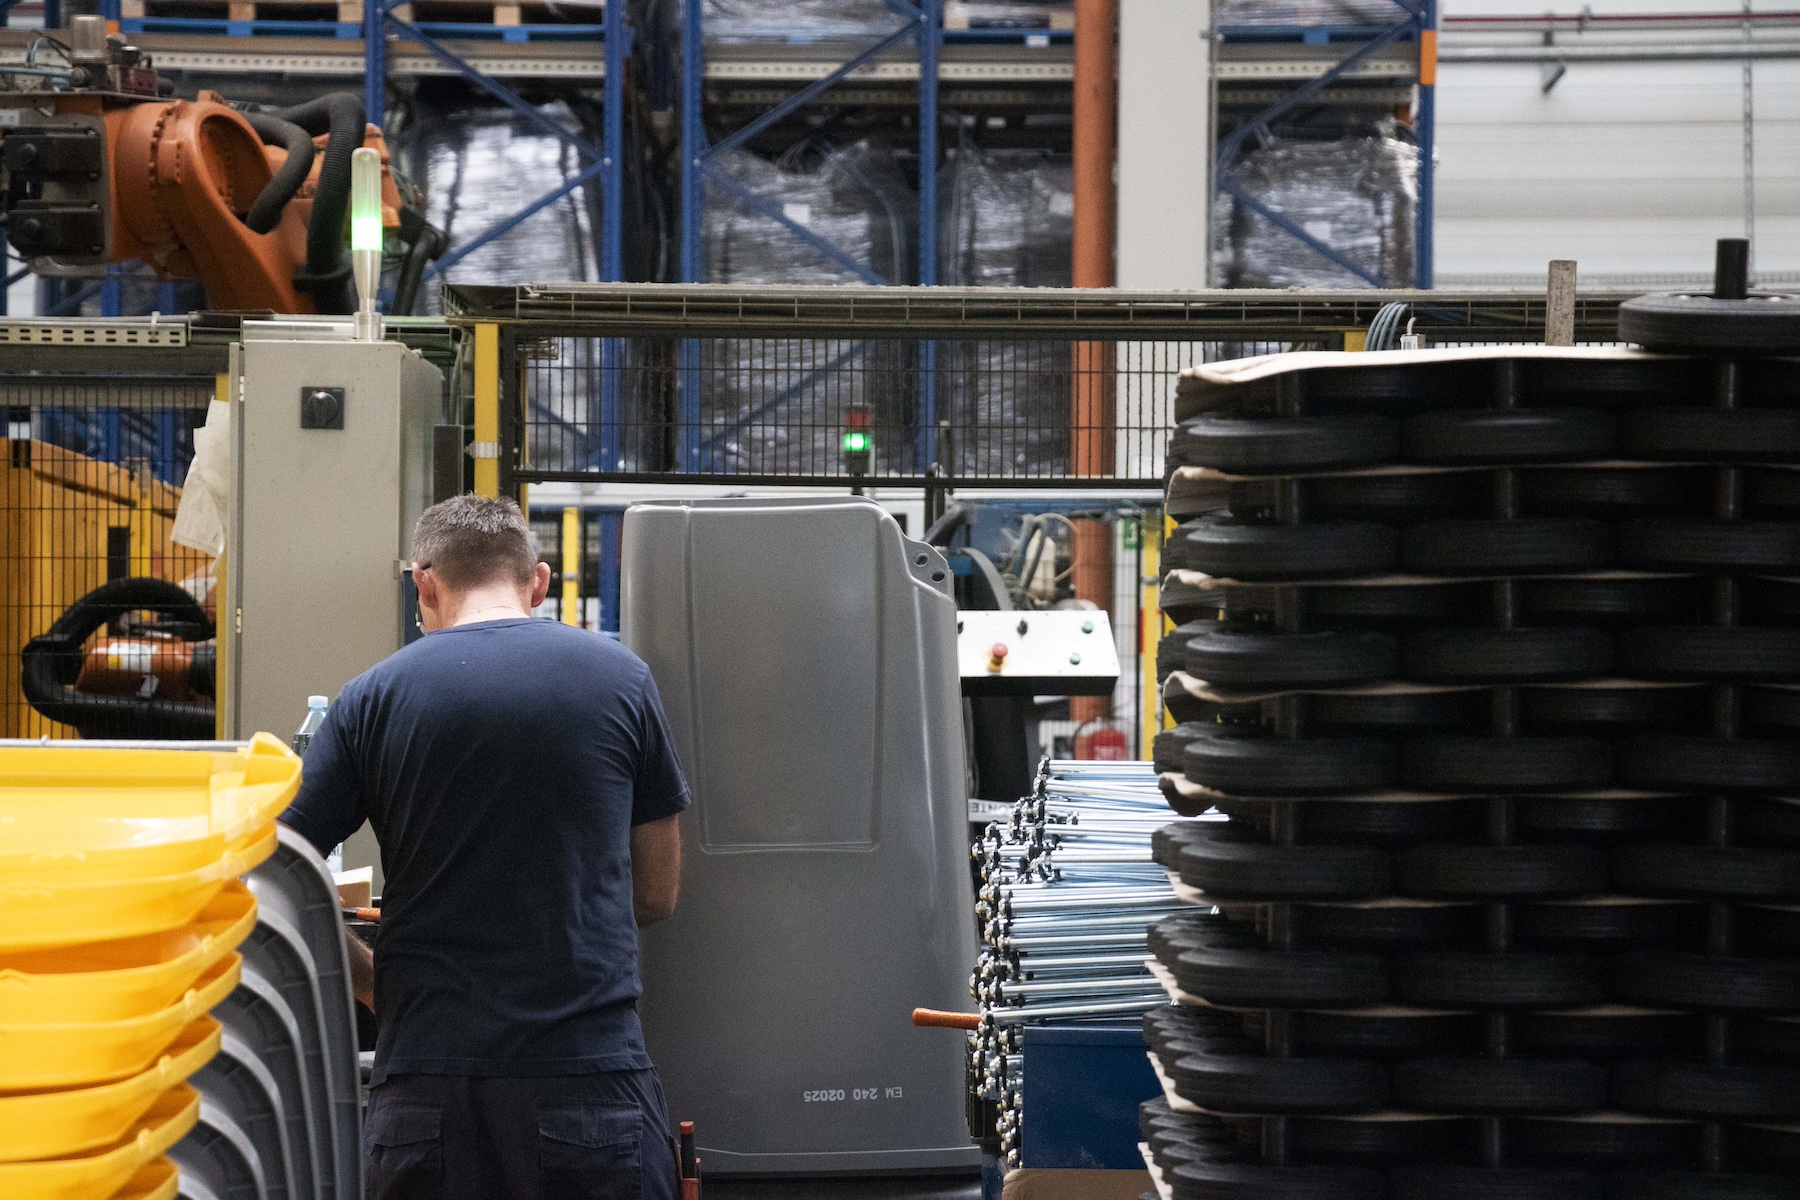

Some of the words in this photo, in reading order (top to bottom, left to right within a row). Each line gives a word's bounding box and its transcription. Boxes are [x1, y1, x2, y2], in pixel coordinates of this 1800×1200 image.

[803, 1088, 846, 1102] 02025
[852, 1087, 878, 1100] 240
[885, 1086, 903, 1098] EM
